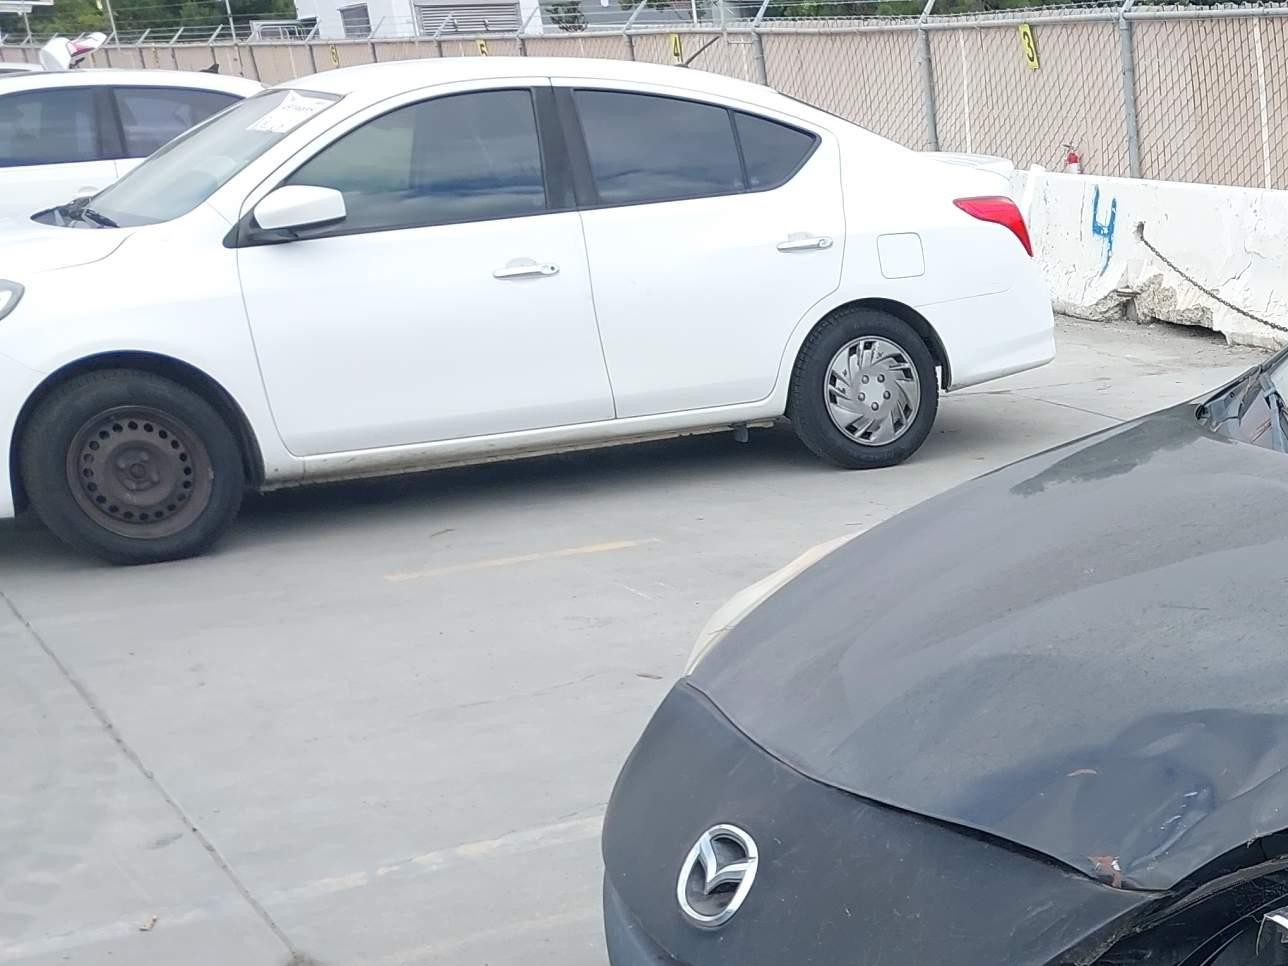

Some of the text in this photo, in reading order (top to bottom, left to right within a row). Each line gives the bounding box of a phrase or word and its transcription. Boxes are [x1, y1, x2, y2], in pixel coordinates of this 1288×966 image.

[673, 36, 681, 63] 4
[1023, 31, 1035, 63] 3
[1092, 184, 1117, 277] 4
